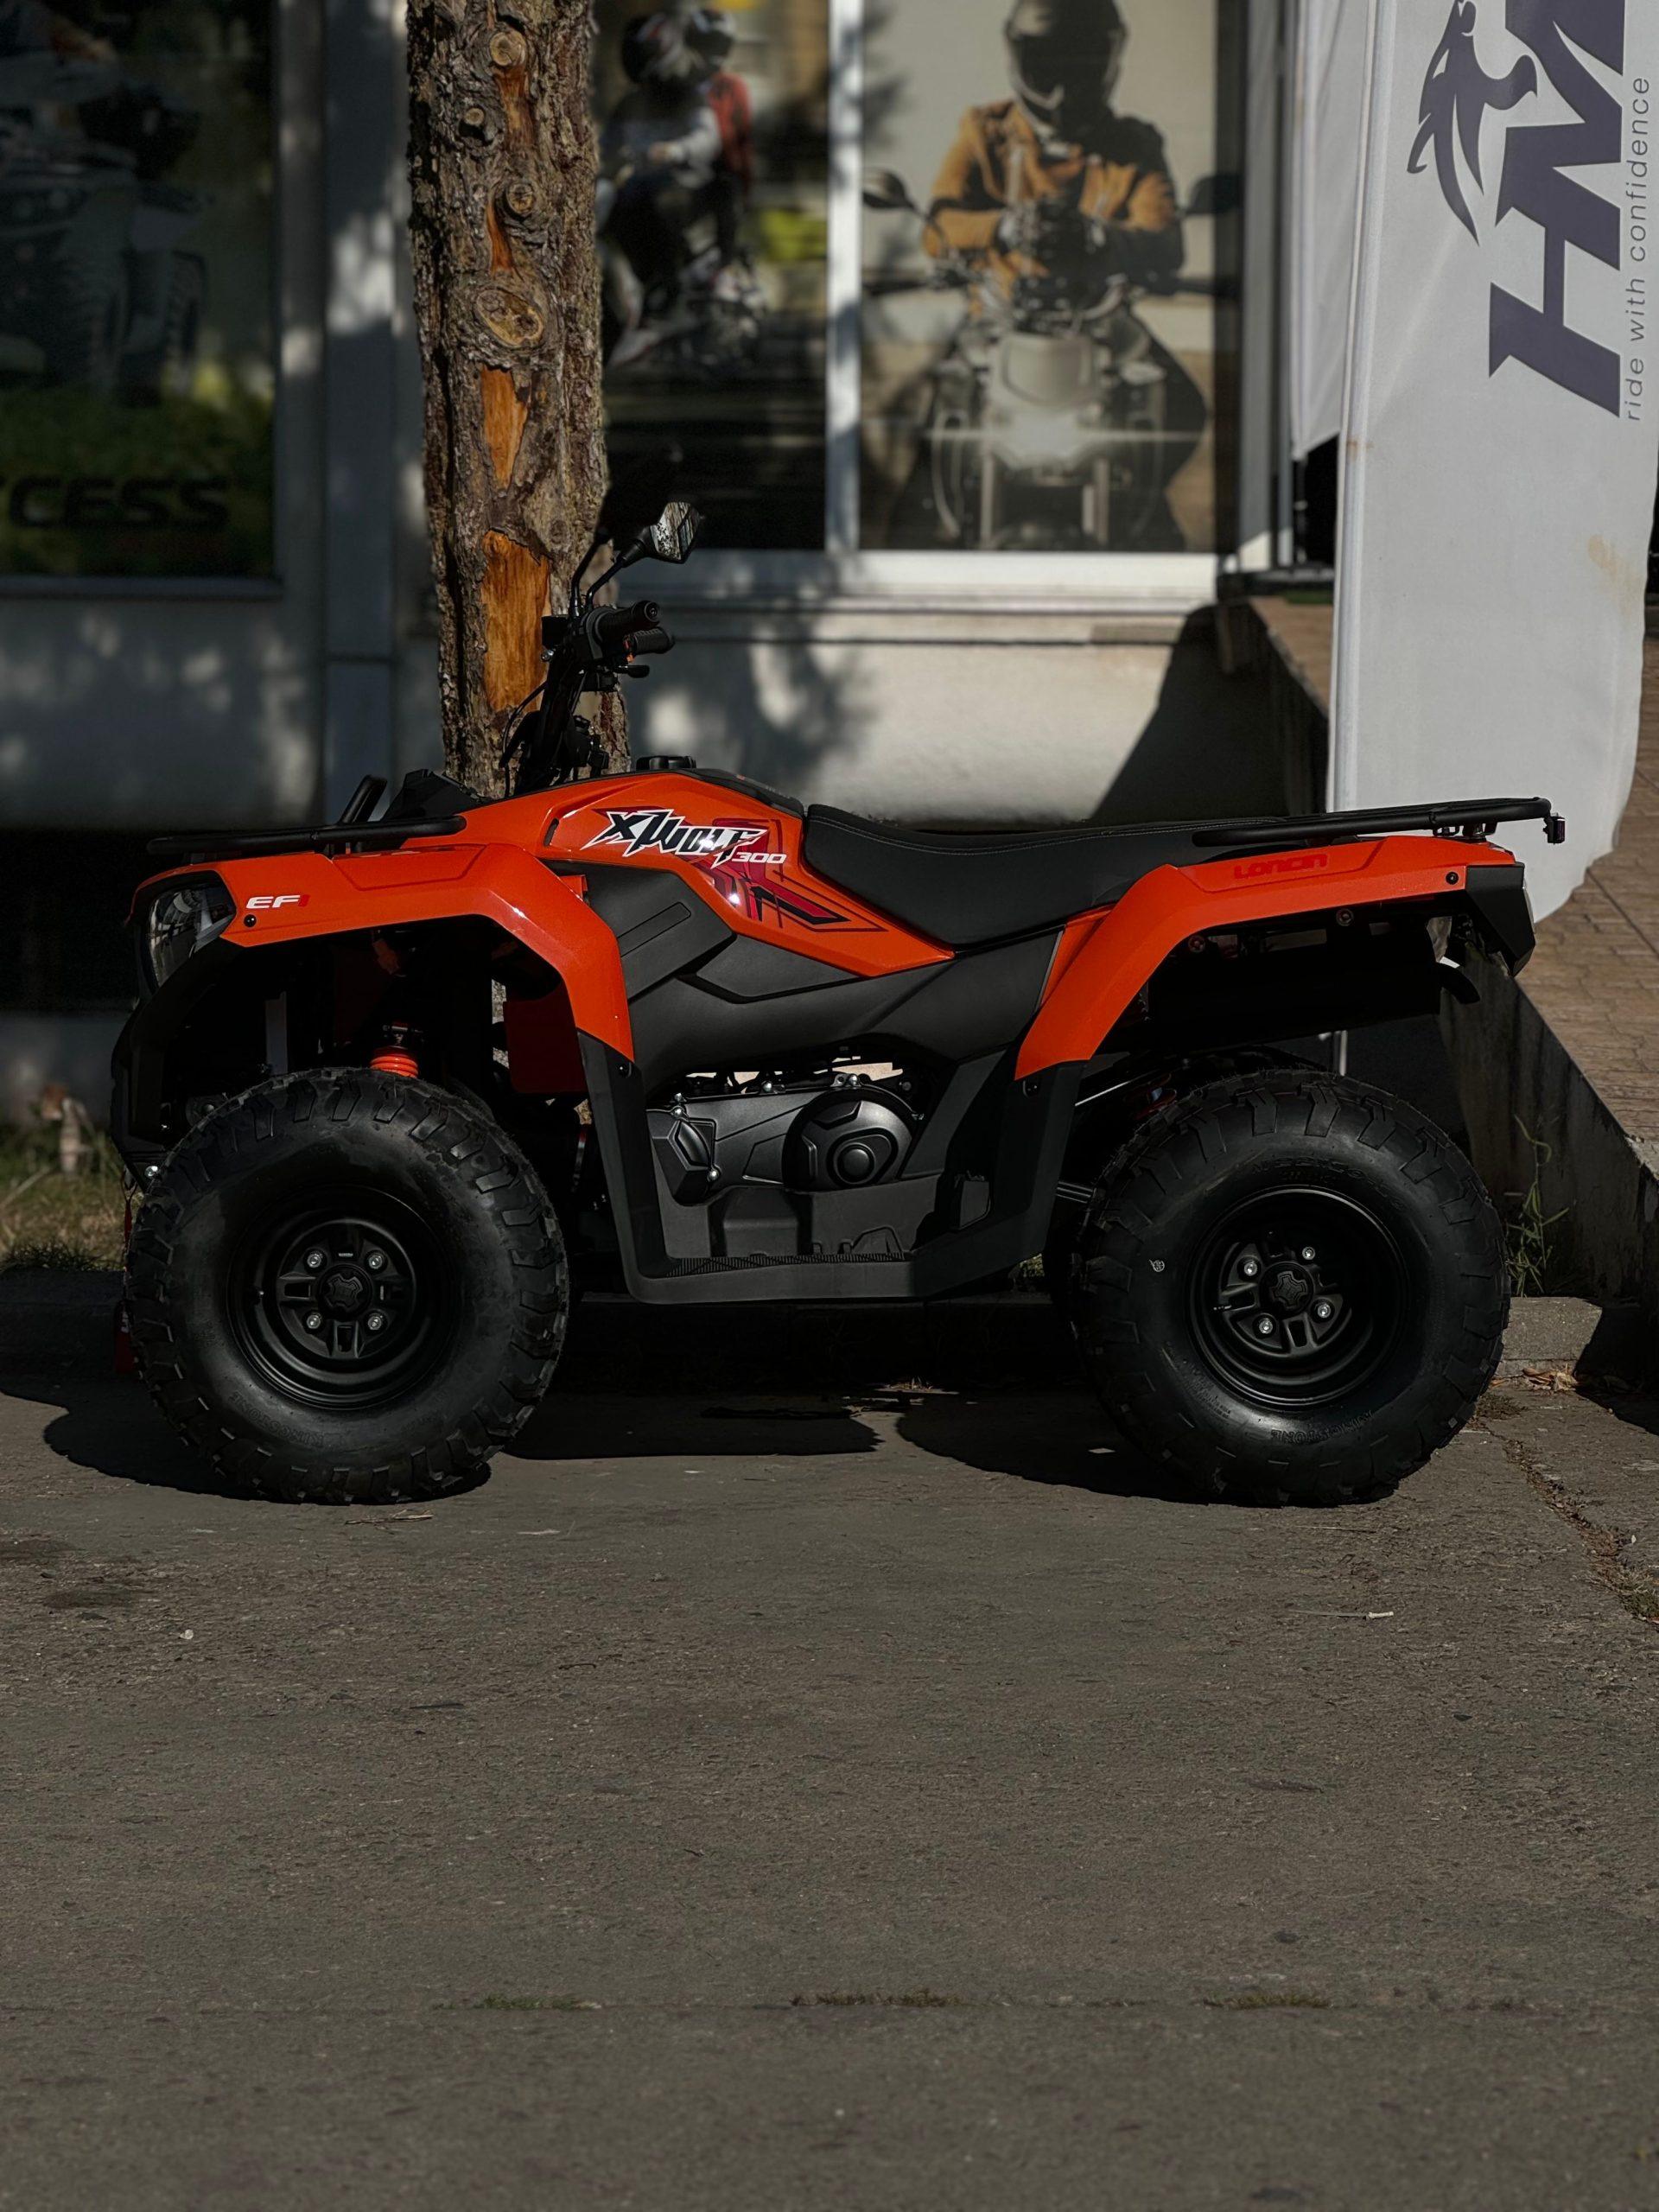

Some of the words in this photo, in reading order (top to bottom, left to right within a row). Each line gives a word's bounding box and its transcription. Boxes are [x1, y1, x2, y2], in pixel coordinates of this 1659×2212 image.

[1625, 77, 1649, 263] confidence
[1624, 277, 1645, 342] with
[1624, 357, 1644, 422] ride
[0, 475, 230, 529] CESS
[731, 851, 788, 865] 300
